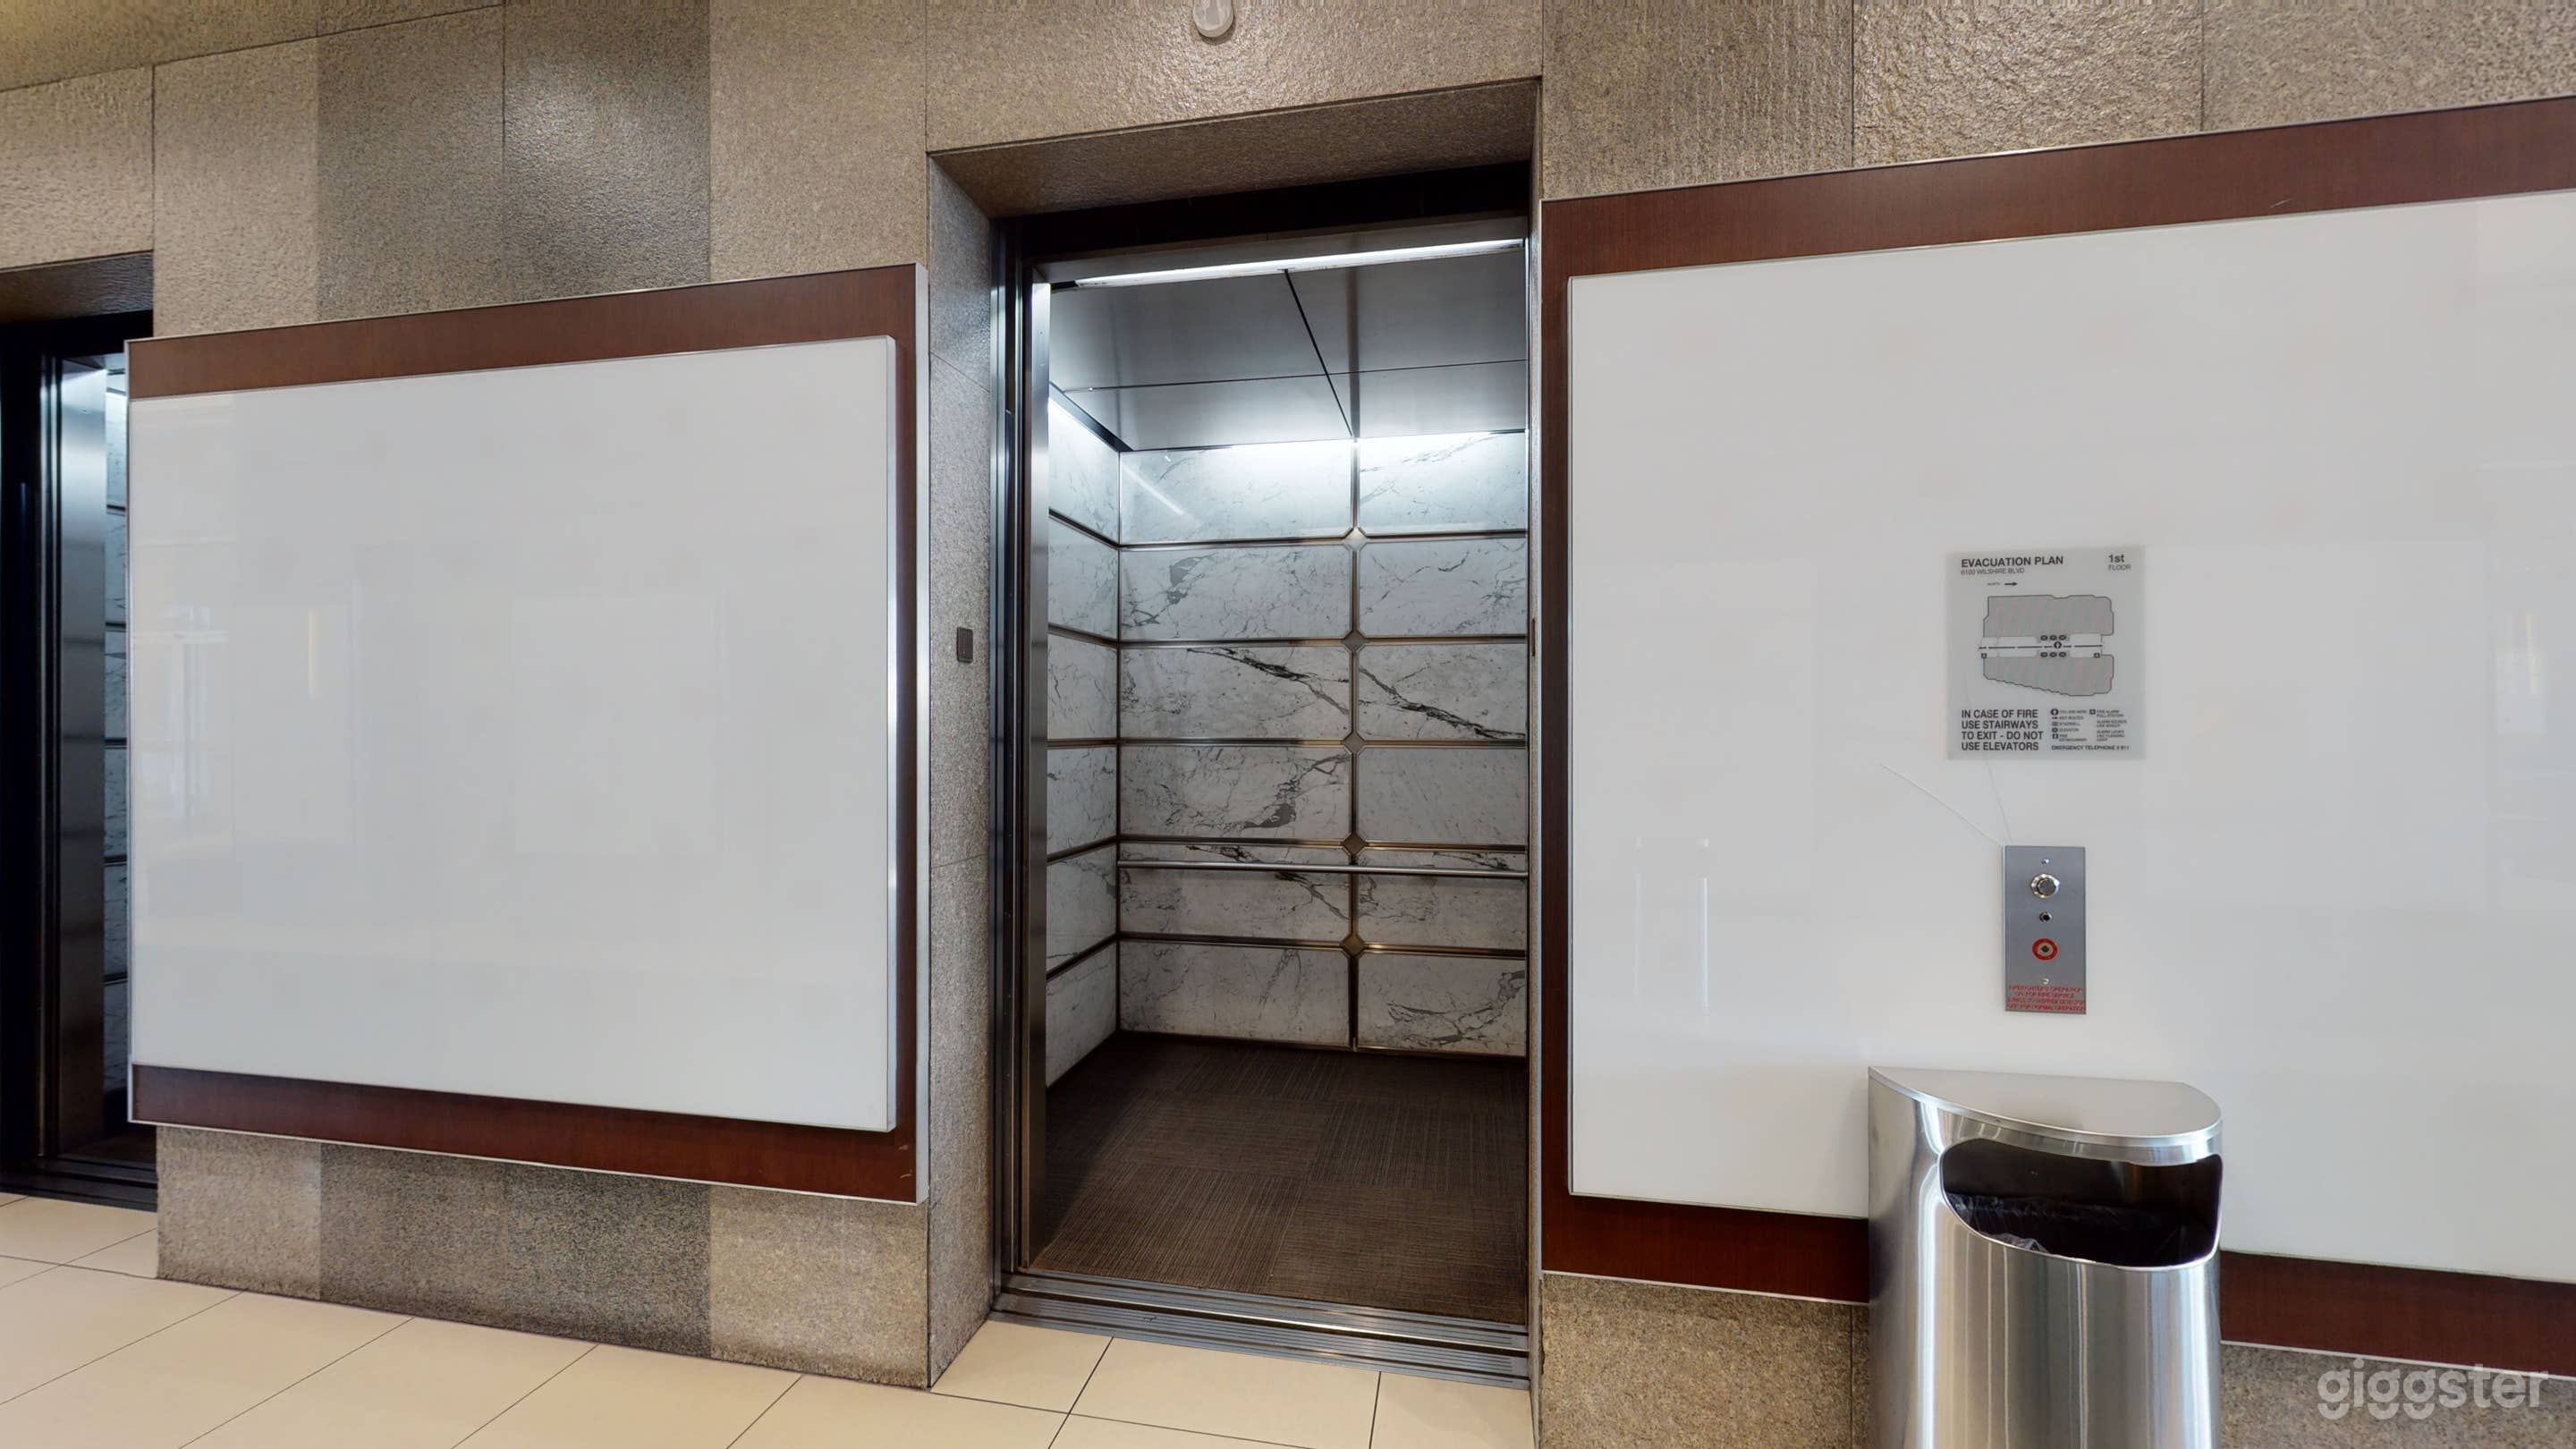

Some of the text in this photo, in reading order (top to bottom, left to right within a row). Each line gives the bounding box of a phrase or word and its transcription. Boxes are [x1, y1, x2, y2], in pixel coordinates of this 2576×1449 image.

[1961, 555, 2063, 568] EVACUATION PLAN
[2108, 554, 2125, 564] 1st
[2108, 564, 2131, 572] FLOOR
[1961, 709, 2038, 718] IN CASE OF FIRE
[1961, 720, 2038, 730] USE STAIRWAYS
[1961, 731, 1974, 741] TO
[1977, 731, 1997, 741] EXIT
[2006, 731, 2021, 741] DO
[2023, 731, 2044, 741] NOT
[1961, 741, 2038, 751] USE ELEVATORS
